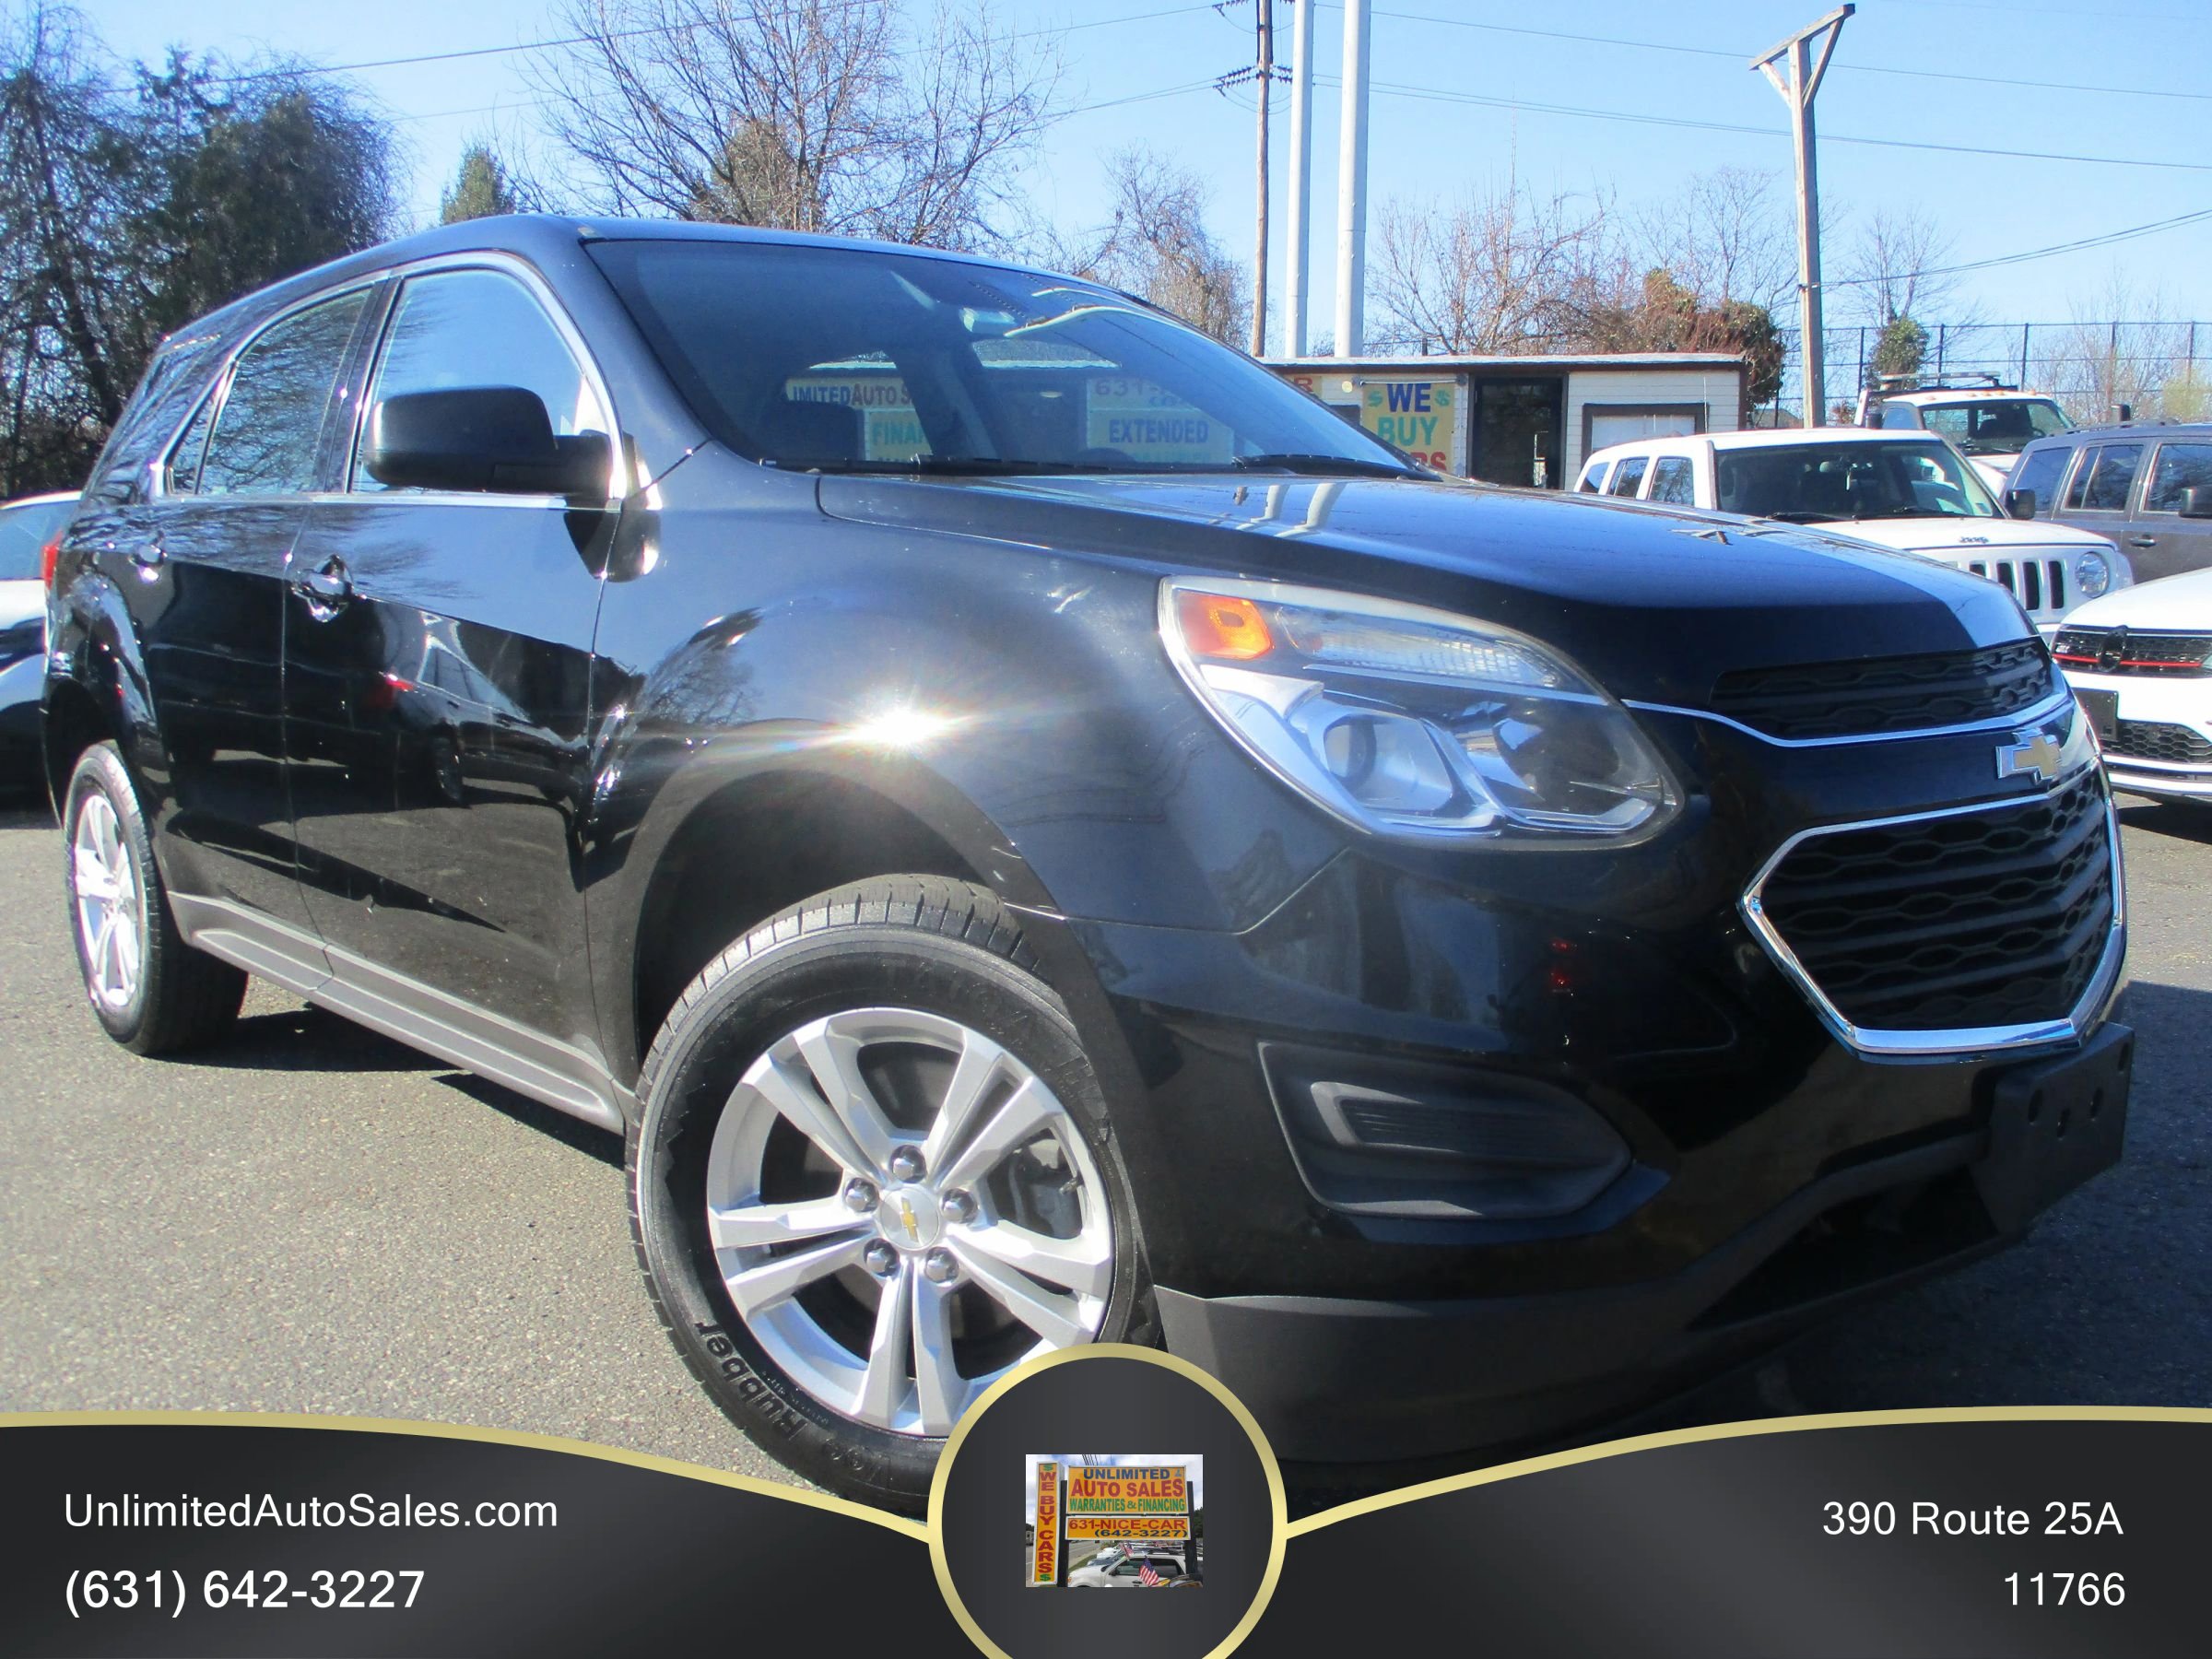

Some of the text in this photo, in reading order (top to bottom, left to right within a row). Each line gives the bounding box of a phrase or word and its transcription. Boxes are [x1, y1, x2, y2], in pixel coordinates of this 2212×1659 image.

[1386, 383, 1431, 412] WE
[1109, 418, 1209, 443] EXTENDED
[1378, 417, 1438, 446] BUY
